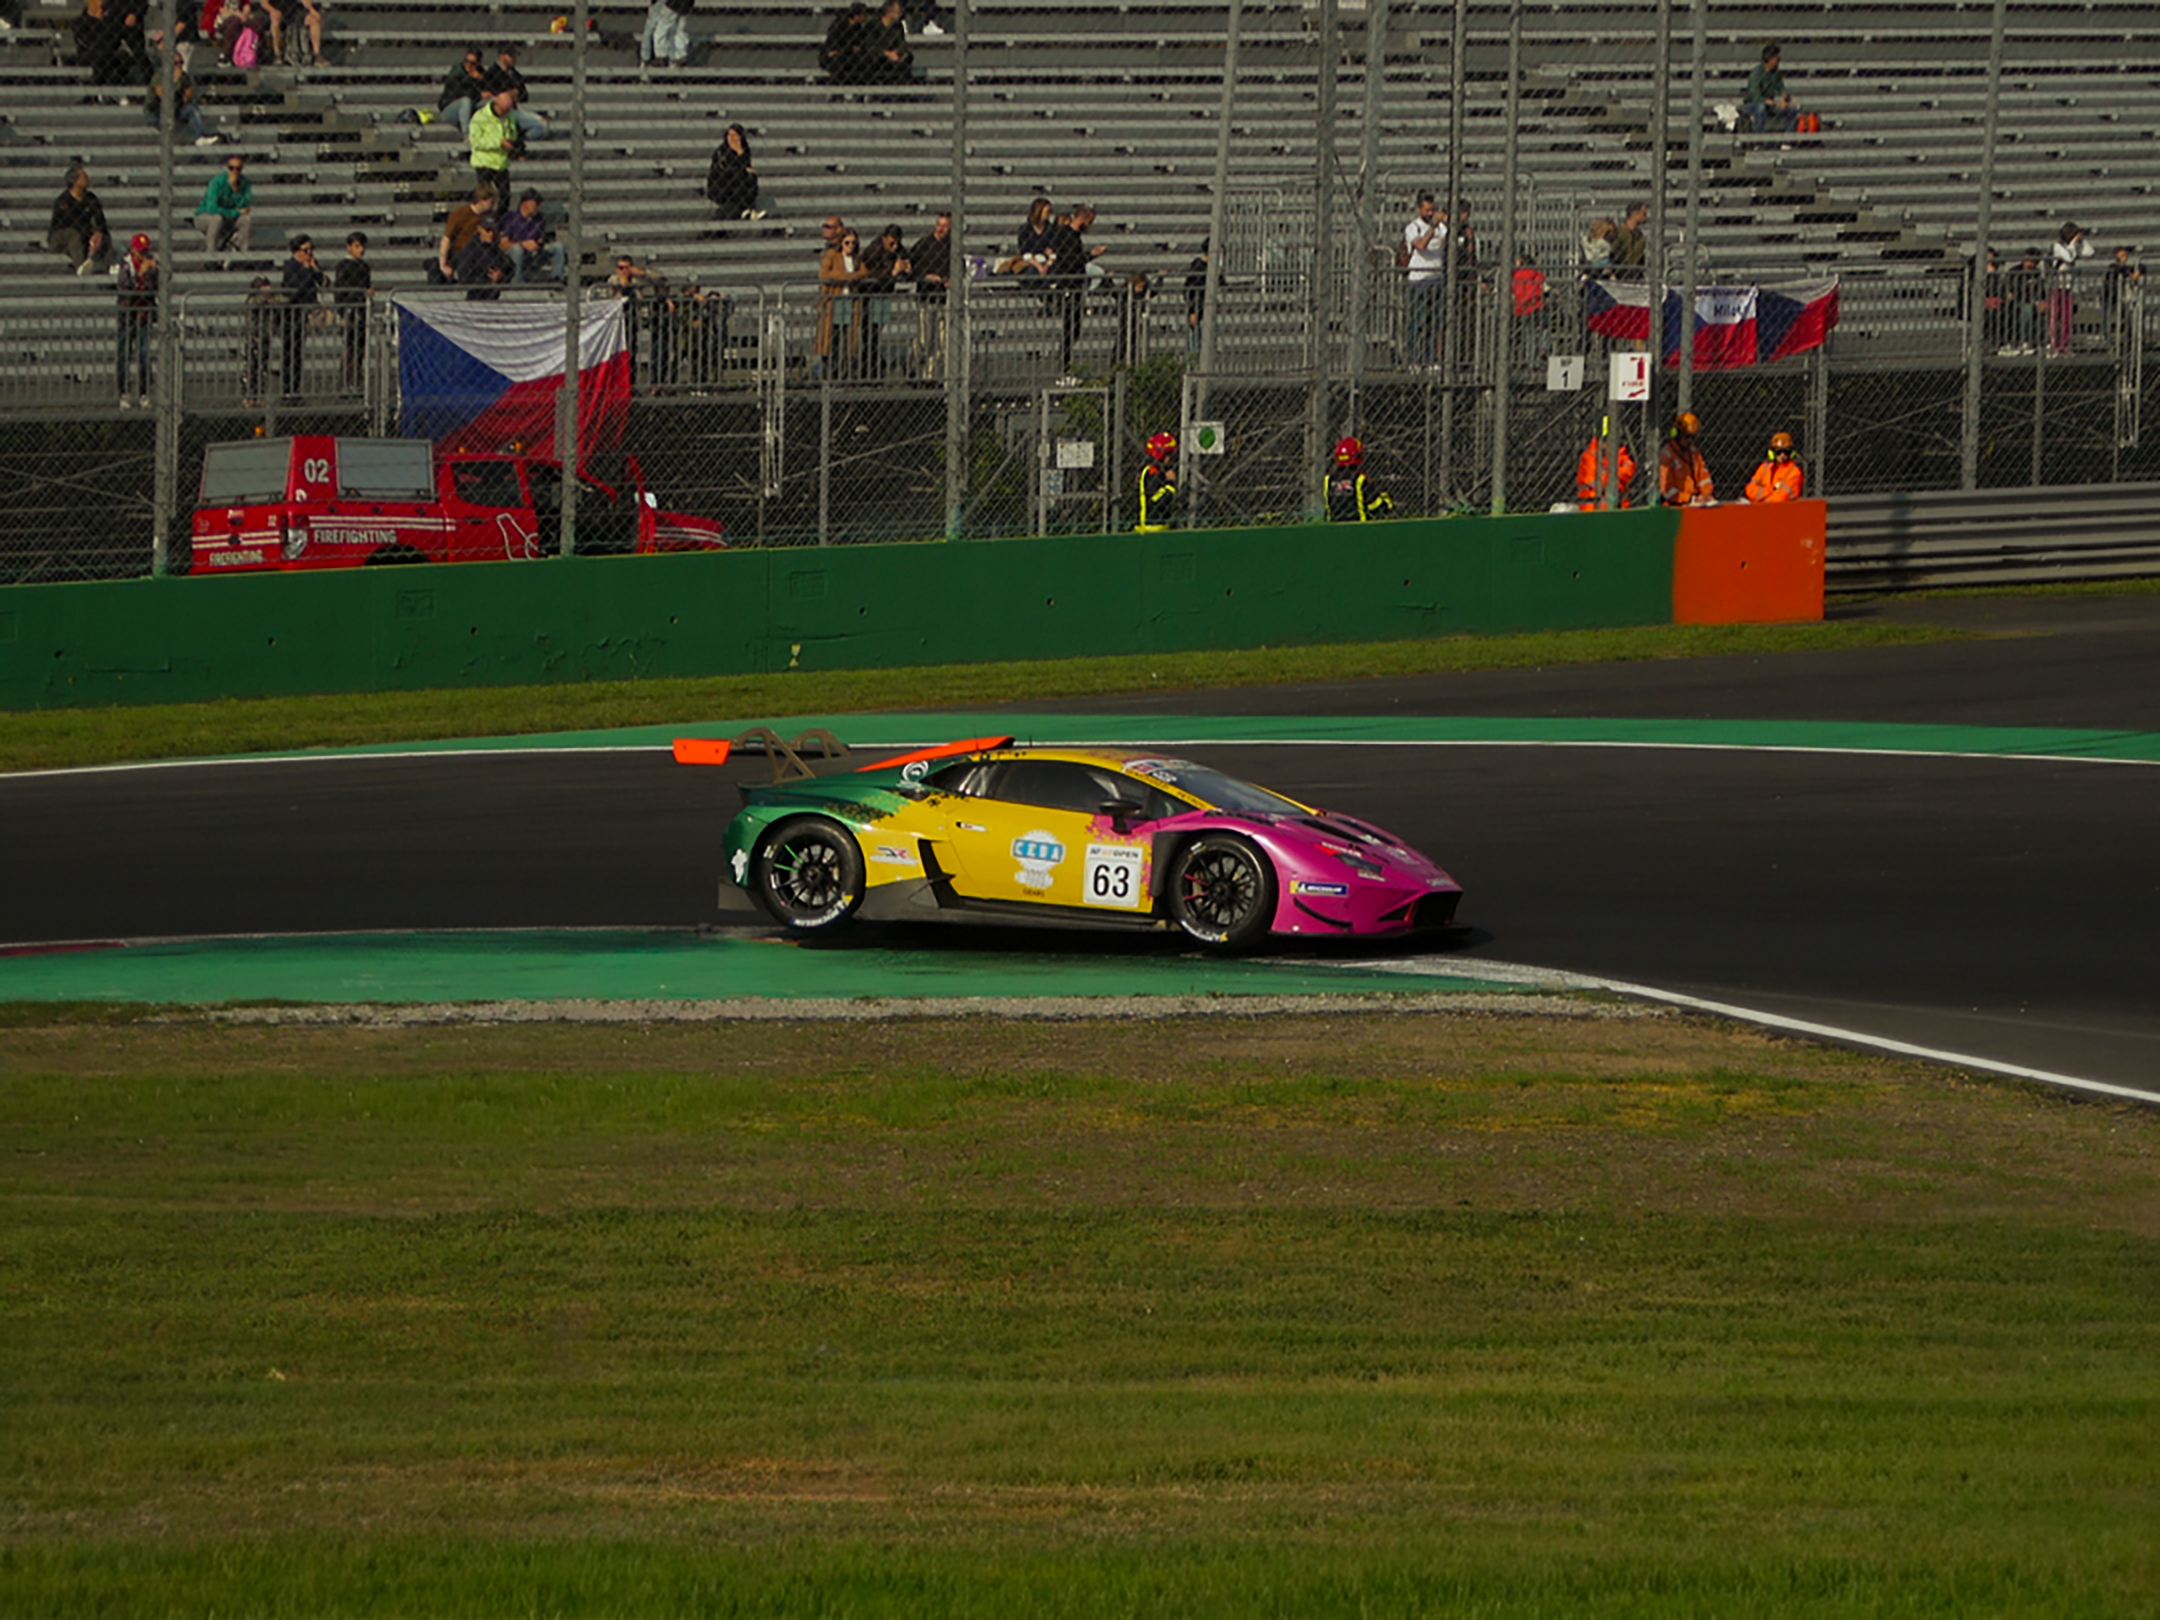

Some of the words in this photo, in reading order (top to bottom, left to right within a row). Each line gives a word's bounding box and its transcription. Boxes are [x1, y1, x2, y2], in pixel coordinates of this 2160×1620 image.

[304, 458, 330, 483] 02
[314, 530, 397, 544] FIREFIGHTING
[1093, 864, 1130, 898] 63
